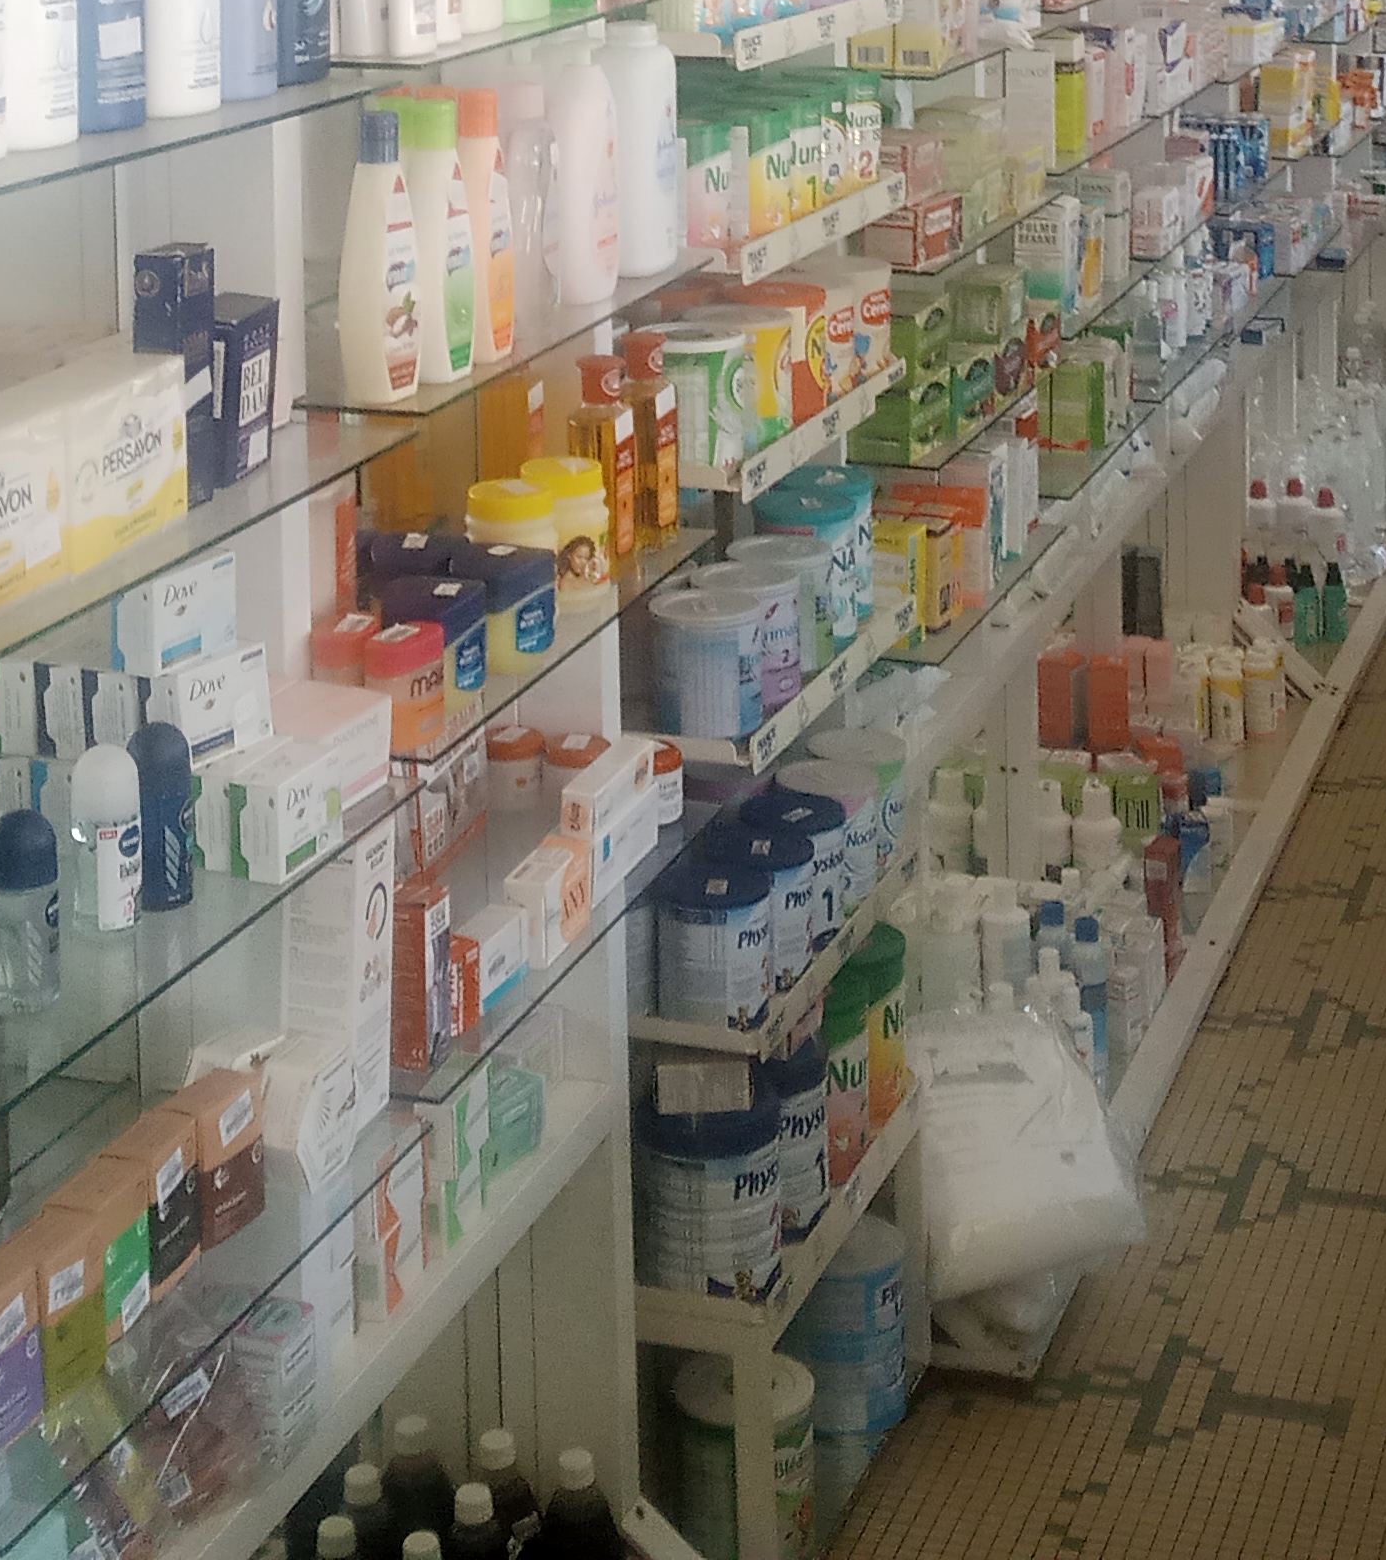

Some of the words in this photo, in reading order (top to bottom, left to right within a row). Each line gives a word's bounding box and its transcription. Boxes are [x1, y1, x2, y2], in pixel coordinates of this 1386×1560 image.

[102, 428, 163, 478] PERSAVON
[162, 580, 198, 608] Dove
[188, 673, 226, 702] Dove
[285, 781, 314, 811] Dove
